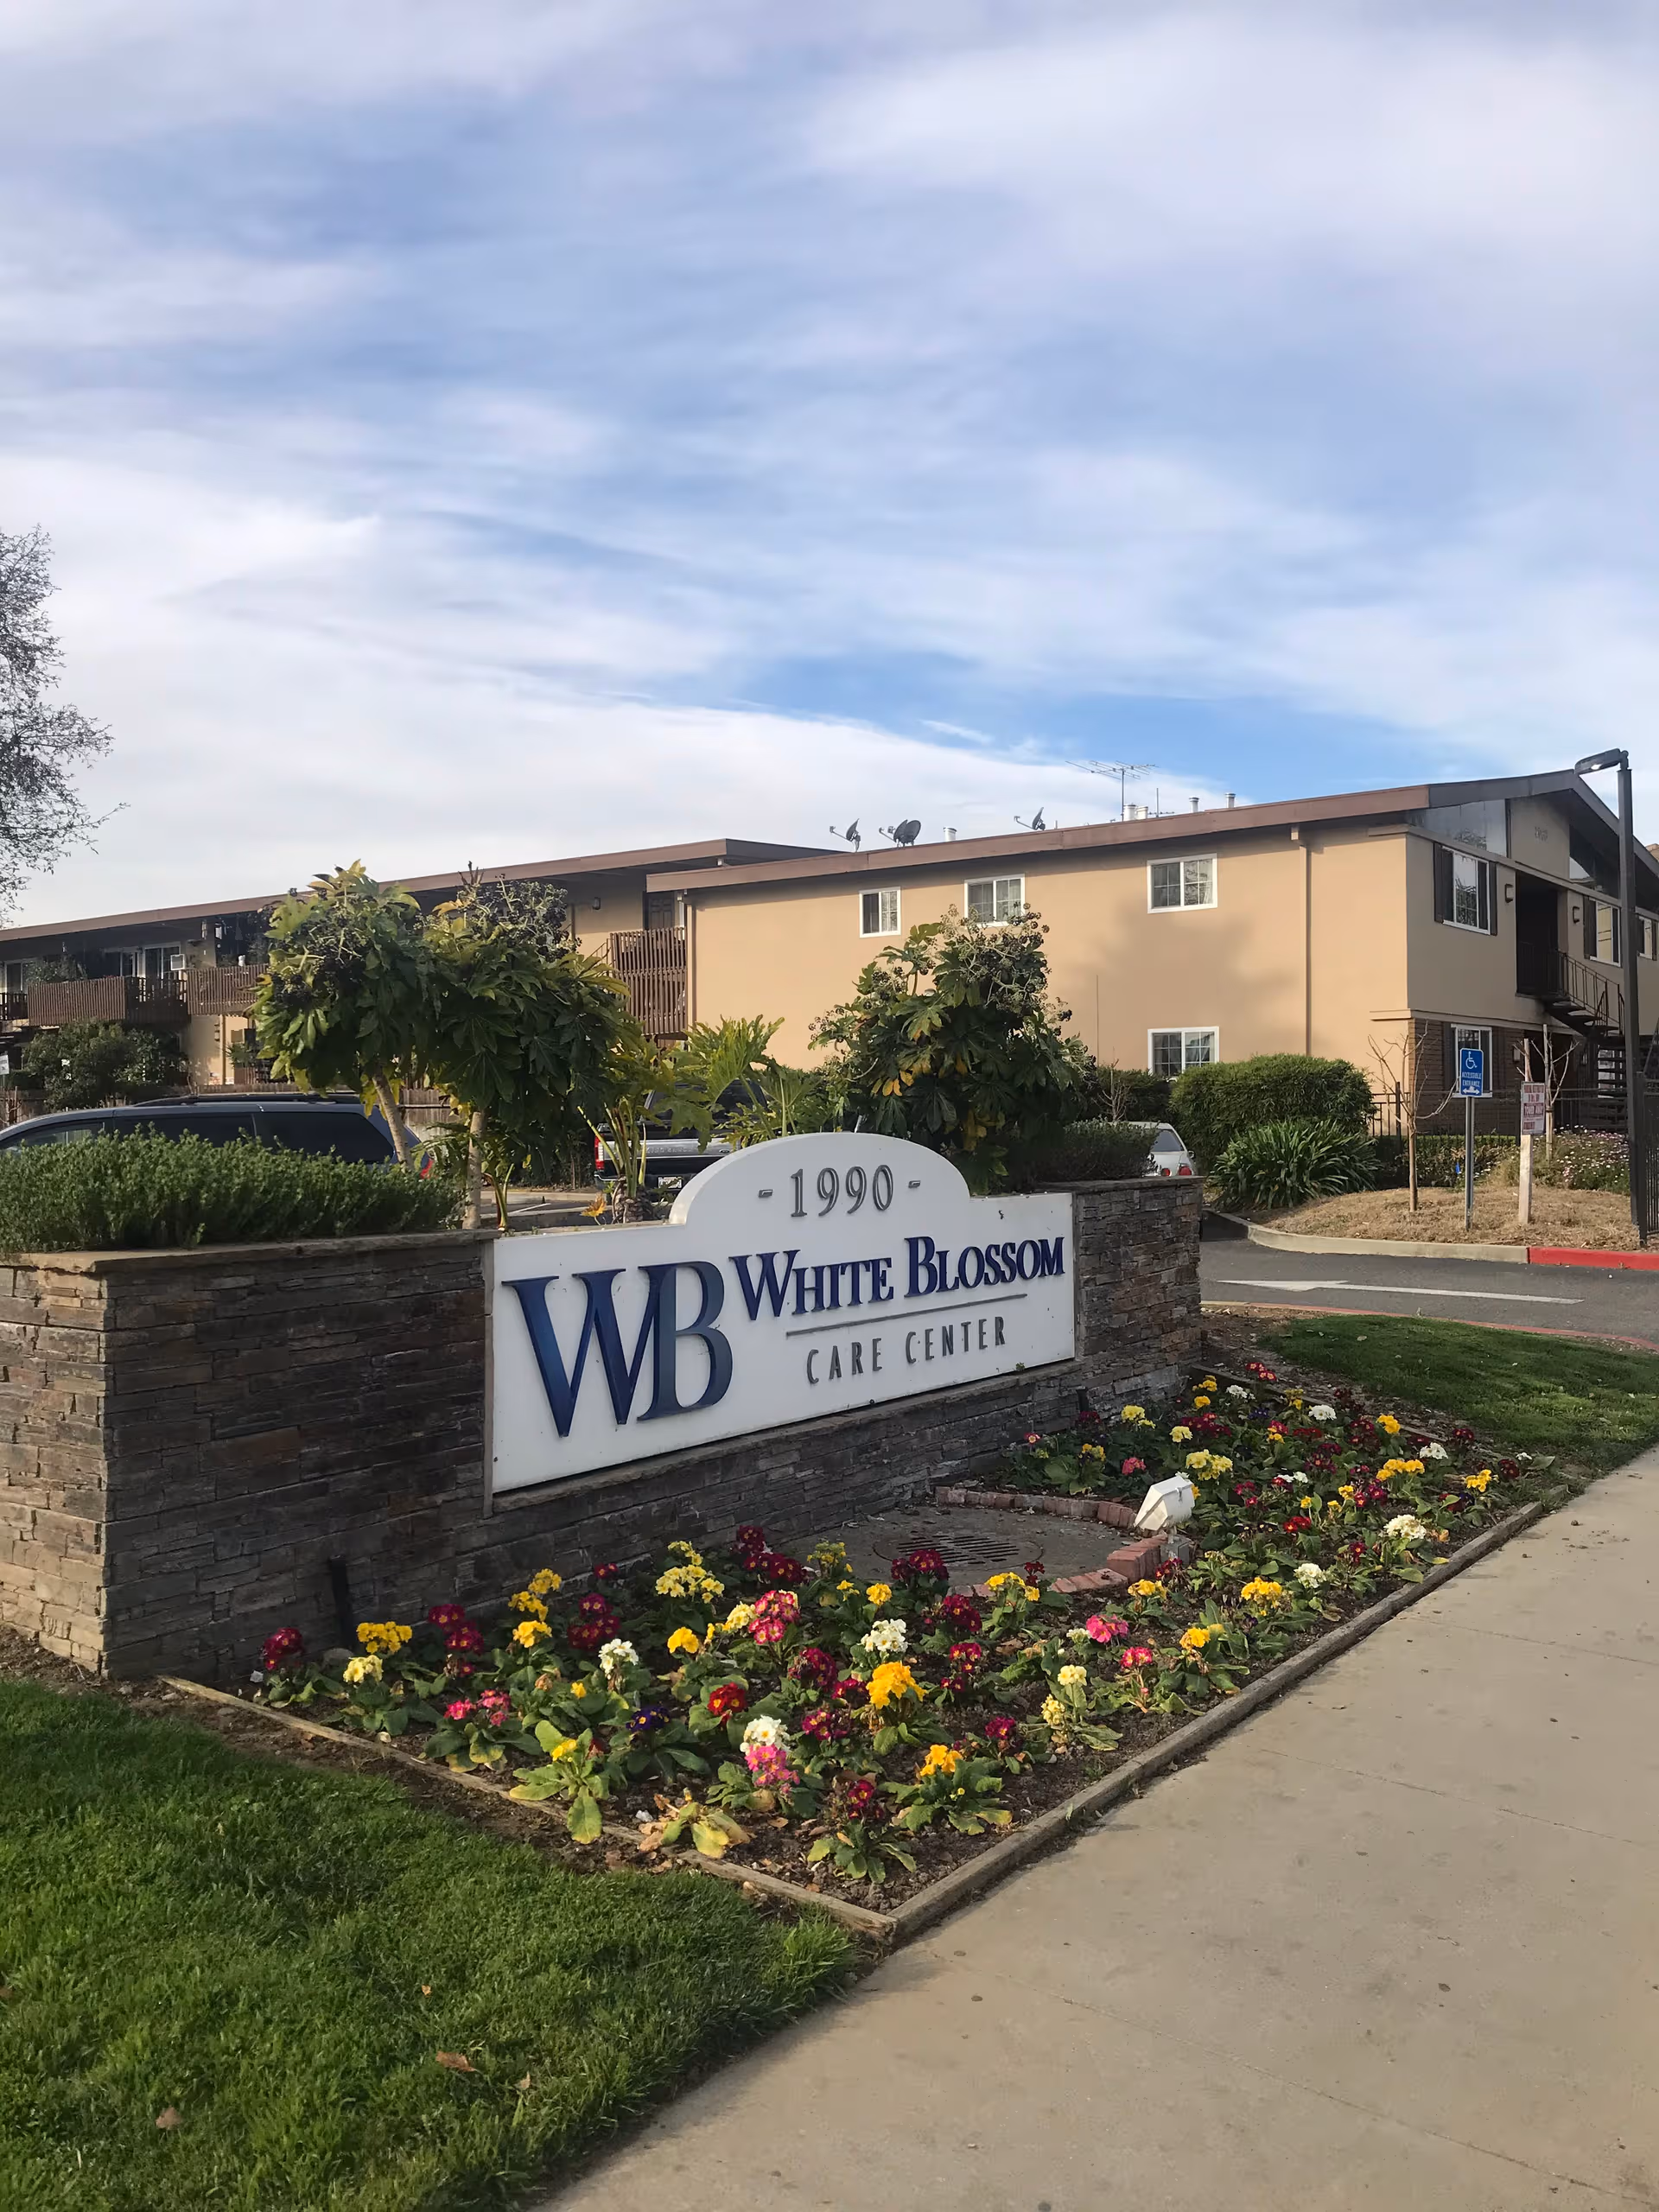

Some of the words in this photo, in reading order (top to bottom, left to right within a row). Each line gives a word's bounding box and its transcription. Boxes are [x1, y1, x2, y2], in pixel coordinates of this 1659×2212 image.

[728, 1249, 895, 1322] WHITE
[904, 1236, 1066, 1298] BLOSSOM
[501, 1261, 734, 1439] WB
[806, 1338, 883, 1384] CARE
[905, 1316, 1007, 1365] CENTER
